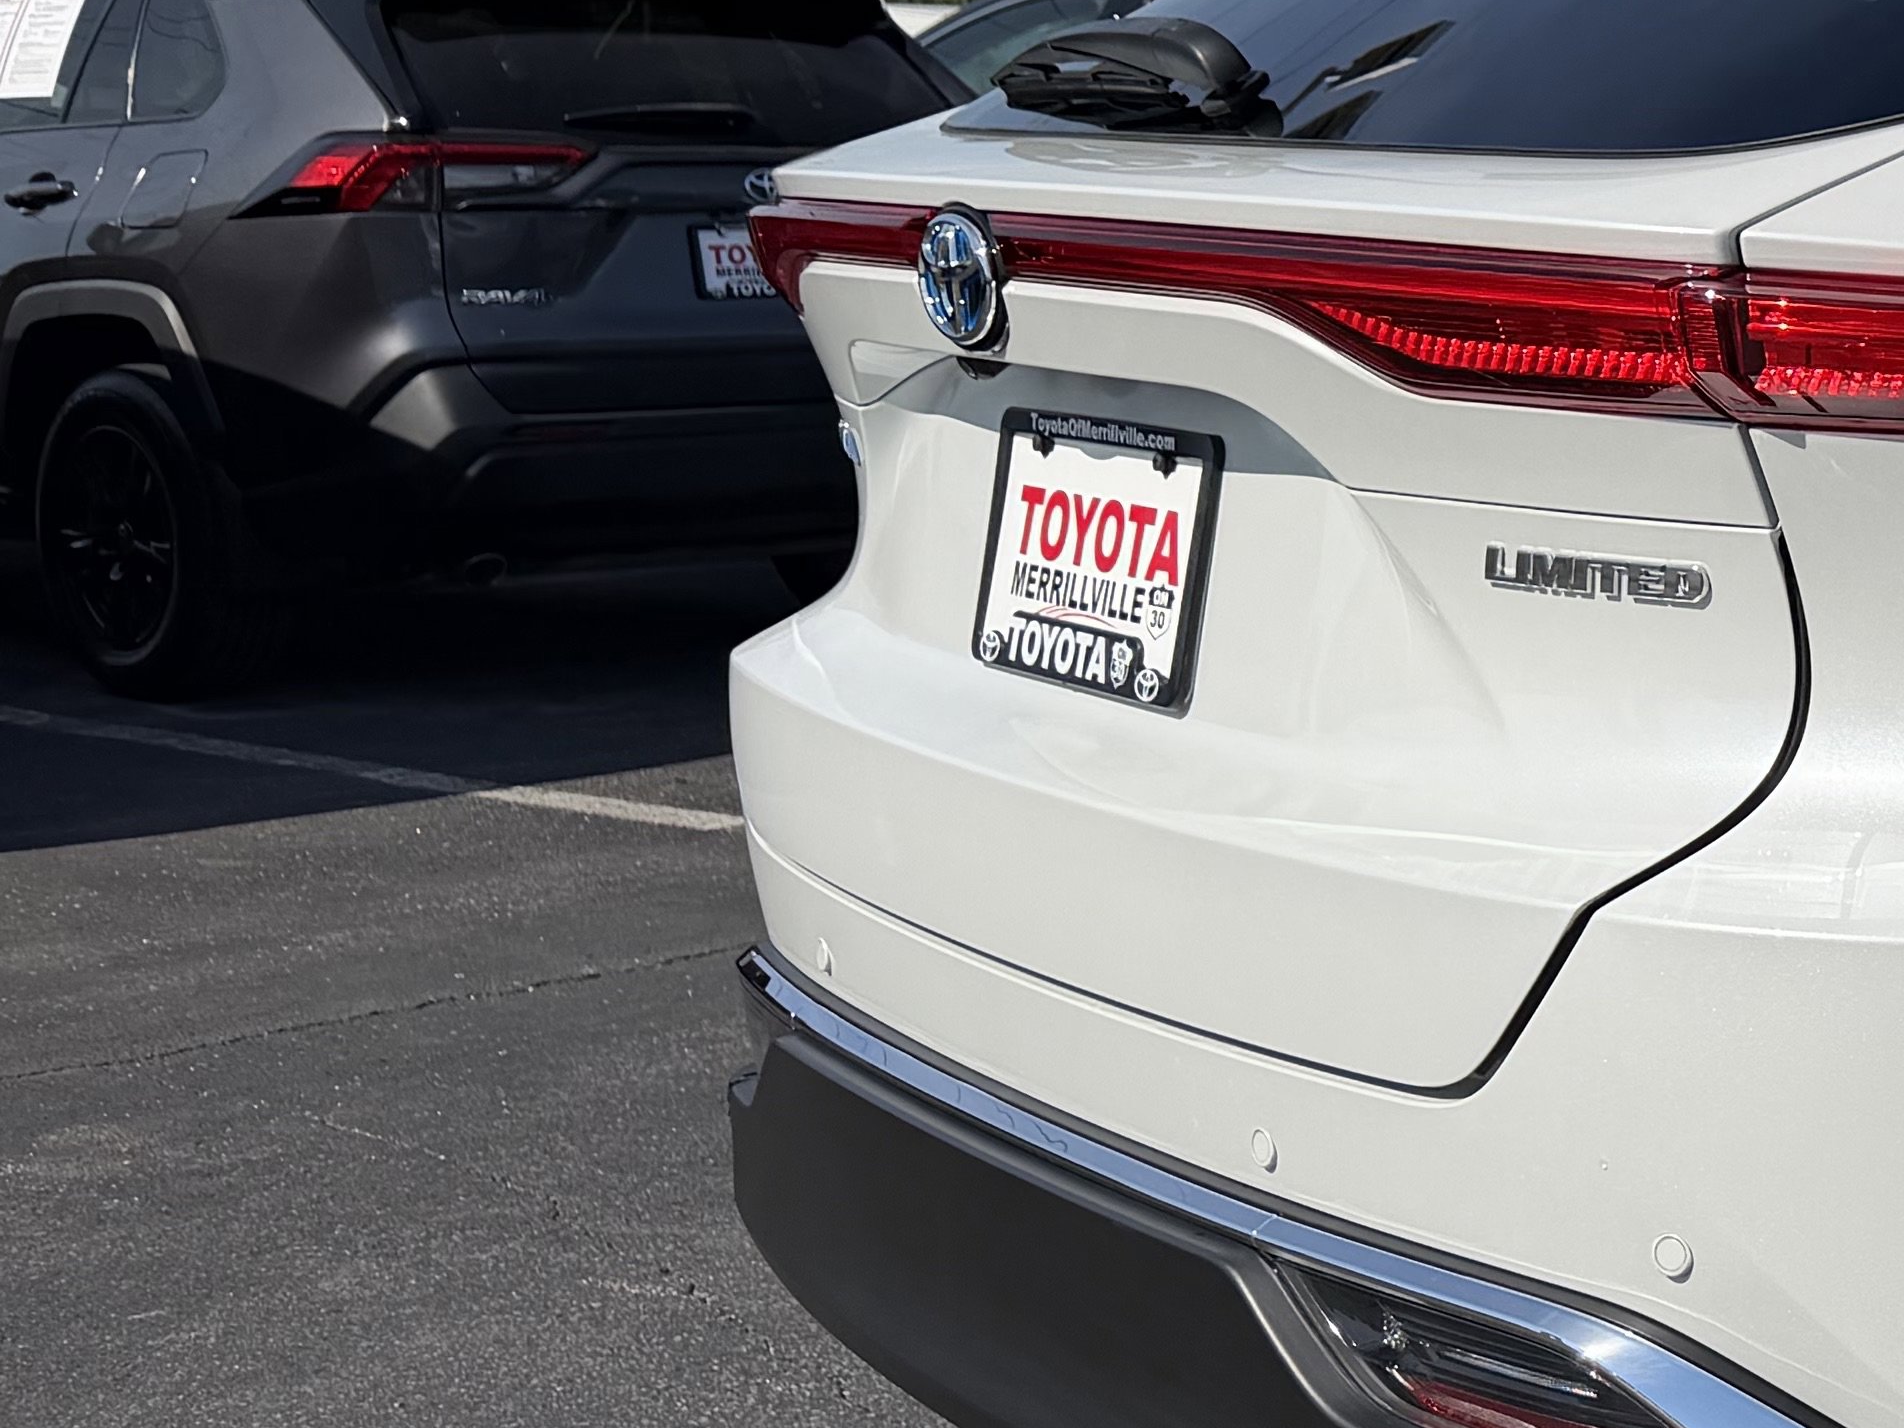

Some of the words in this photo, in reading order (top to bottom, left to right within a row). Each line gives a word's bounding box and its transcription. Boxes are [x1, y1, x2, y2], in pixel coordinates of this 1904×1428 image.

[462, 287, 553, 307] RAV4
[1030, 411, 1176, 451] ToyotaOfMerrillville.com
[1019, 484, 1179, 587] TOYOTA
[1010, 560, 1147, 625] MERRILLVILLE
[1153, 589, 1169, 606] ON
[1484, 541, 1713, 610] LIMITED
[1005, 616, 1106, 684] TOYOTA
[1149, 609, 1165, 630] 30
